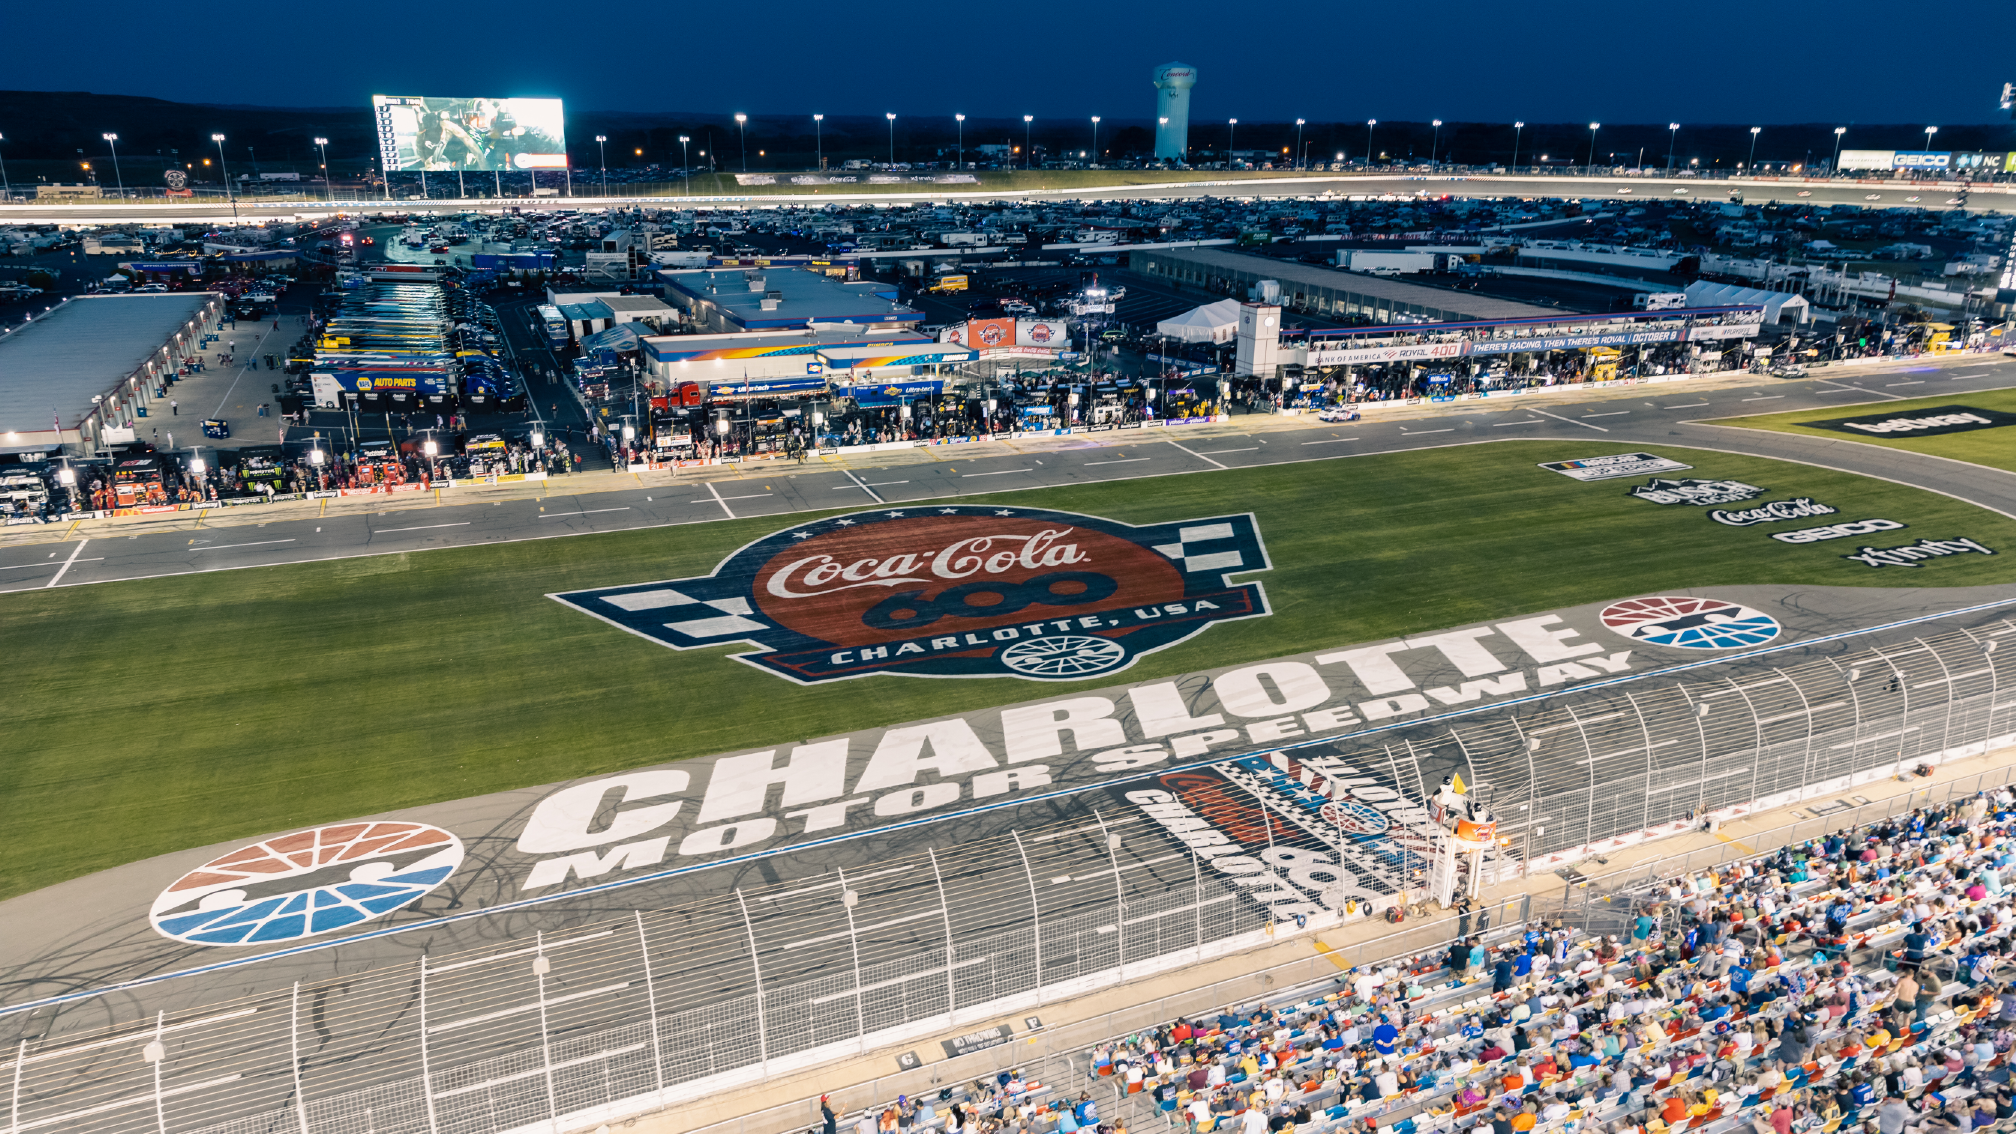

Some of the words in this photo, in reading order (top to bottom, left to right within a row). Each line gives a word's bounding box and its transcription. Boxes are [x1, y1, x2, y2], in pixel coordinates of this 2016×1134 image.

[1894, 154, 1950, 166] GEICO
[1982, 156, 2000, 167] NC
[1473, 342, 1508, 352] THERE'S
[1509, 340, 1542, 351] RACING,
[1544, 338, 1566, 348] THEN
[1567, 337, 1599, 347] THERE'S
[1632, 332, 1669, 343] OCTOBER
[1315, 355, 1336, 364] BANK
[1337, 355, 1347, 363] OF
[1348, 353, 1381, 361] AMERICA
[1430, 345, 1457, 356] 400
[374, 378, 392, 387] AUTO
[393, 378, 416, 387] PARTS
[1843, 412, 1992, 433] betway
[1632, 480, 1762, 504] BUSCH
[1712, 498, 1836, 526] Coca-Cola
[1772, 519, 1904, 543] GEICO
[767, 527, 1084, 598] Coca-Cola
[1847, 538, 1993, 567] xfinity
[861, 571, 1118, 630] 600
[830, 615, 1120, 666] CHARLOTTE,
[1134, 599, 1221, 619] USA
[516, 614, 1605, 854] CHARLOTTE
[521, 764, 1052, 891] MOTOR
[1091, 650, 1632, 774] SPEEDWAY
[1124, 788, 1332, 922] CHARLOTTE
[953, 1037, 965, 1048] NO
[965, 1027, 1002, 1044] THROWING
[902, 1053, 914, 1066] G
